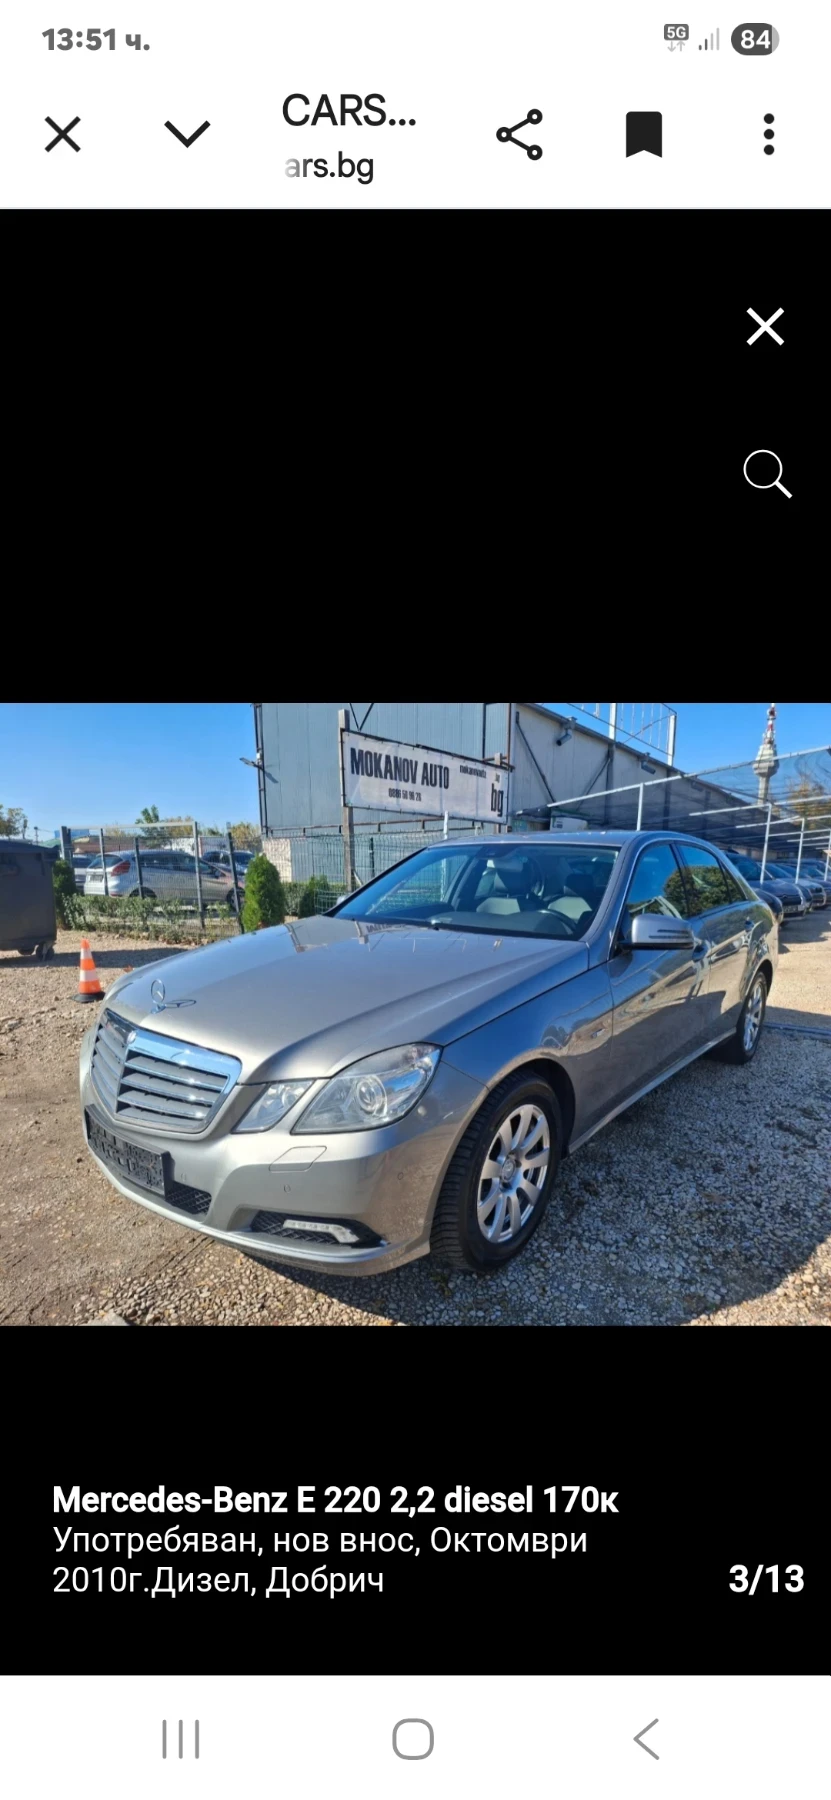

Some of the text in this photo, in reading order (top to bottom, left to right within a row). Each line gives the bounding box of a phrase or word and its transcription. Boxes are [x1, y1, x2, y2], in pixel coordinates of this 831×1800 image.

[350, 748, 450, 790] MOKANOV AUTO
[490, 782, 504, 818] bg
